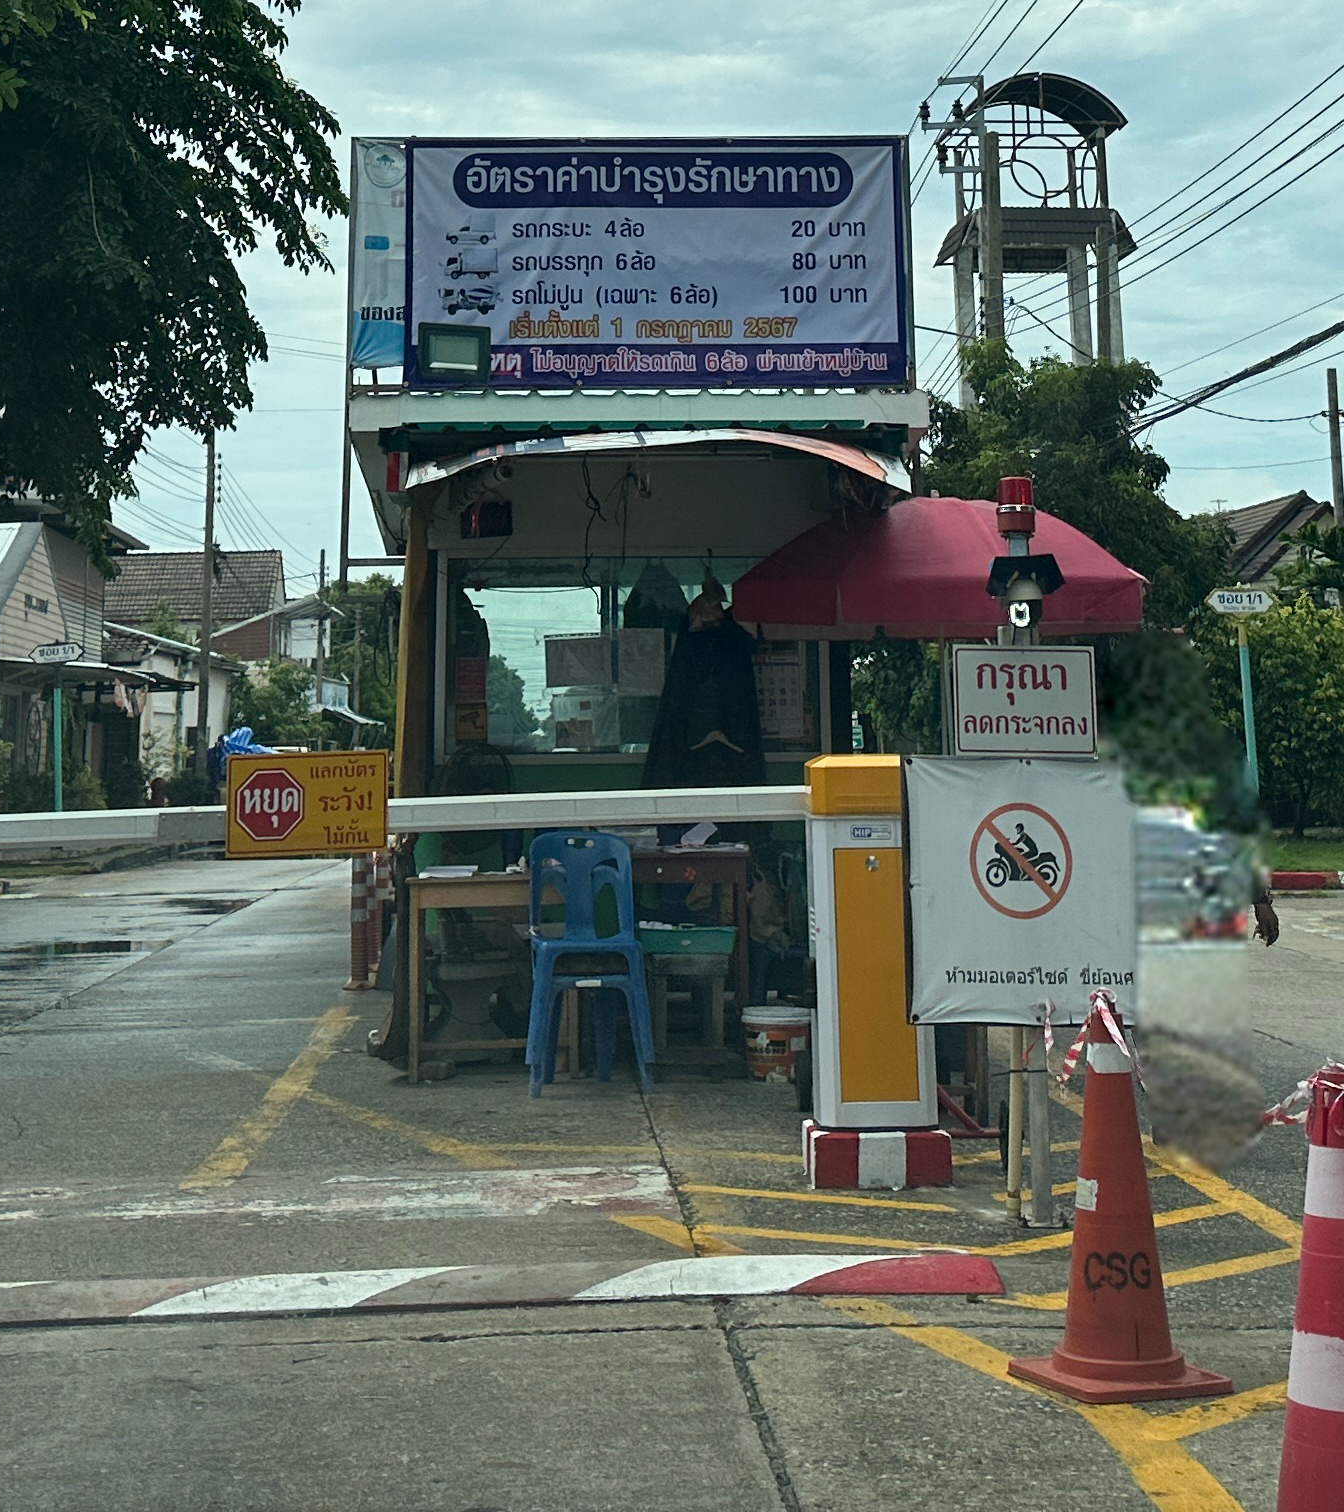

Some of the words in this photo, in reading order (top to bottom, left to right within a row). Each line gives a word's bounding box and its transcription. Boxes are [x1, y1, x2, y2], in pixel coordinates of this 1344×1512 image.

[466, 157, 841, 204] อัตราค่าบำรุงรักษาทาง
[512, 222, 591, 238] รถกระบะ
[791, 220, 816, 238] 20
[829, 221, 866, 237] บาท
[512, 254, 603, 277] รถบรรทุก
[792, 252, 816, 270] 80
[829, 254, 867, 270] บาท
[512, 281, 583, 311] รถโม่ปูน
[596, 286, 657, 308] (เฉพาะ
[780, 286, 817, 304] 100
[830, 287, 868, 303] บาท
[509, 309, 599, 339] เริ่มตั้งแต่
[611, 317, 623, 338] 1
[636, 319, 733, 343] กรกฎาคม
[743, 316, 798, 338] 2567
[530, 346, 696, 378] ไม่อนุญาตให้รถเกิน
[756, 348, 888, 378] ผ่านเข้าหมู่บ้าน
[1217, 593, 1243, 604] ซอย
[1246, 593, 1263, 604] 1/1
[976, 663, 1067, 706] กรุณา
[964, 714, 1088, 735] ลดกระจกลง
[310, 759, 377, 779] แลกบัตร
[242, 787, 299, 829] หยุด
[318, 786, 373, 812] ระวัง!
[323, 818, 369, 845] ไม้กั้น
[854, 828, 871, 837] HIP
[1083, 1251, 1151, 1291] CSG
